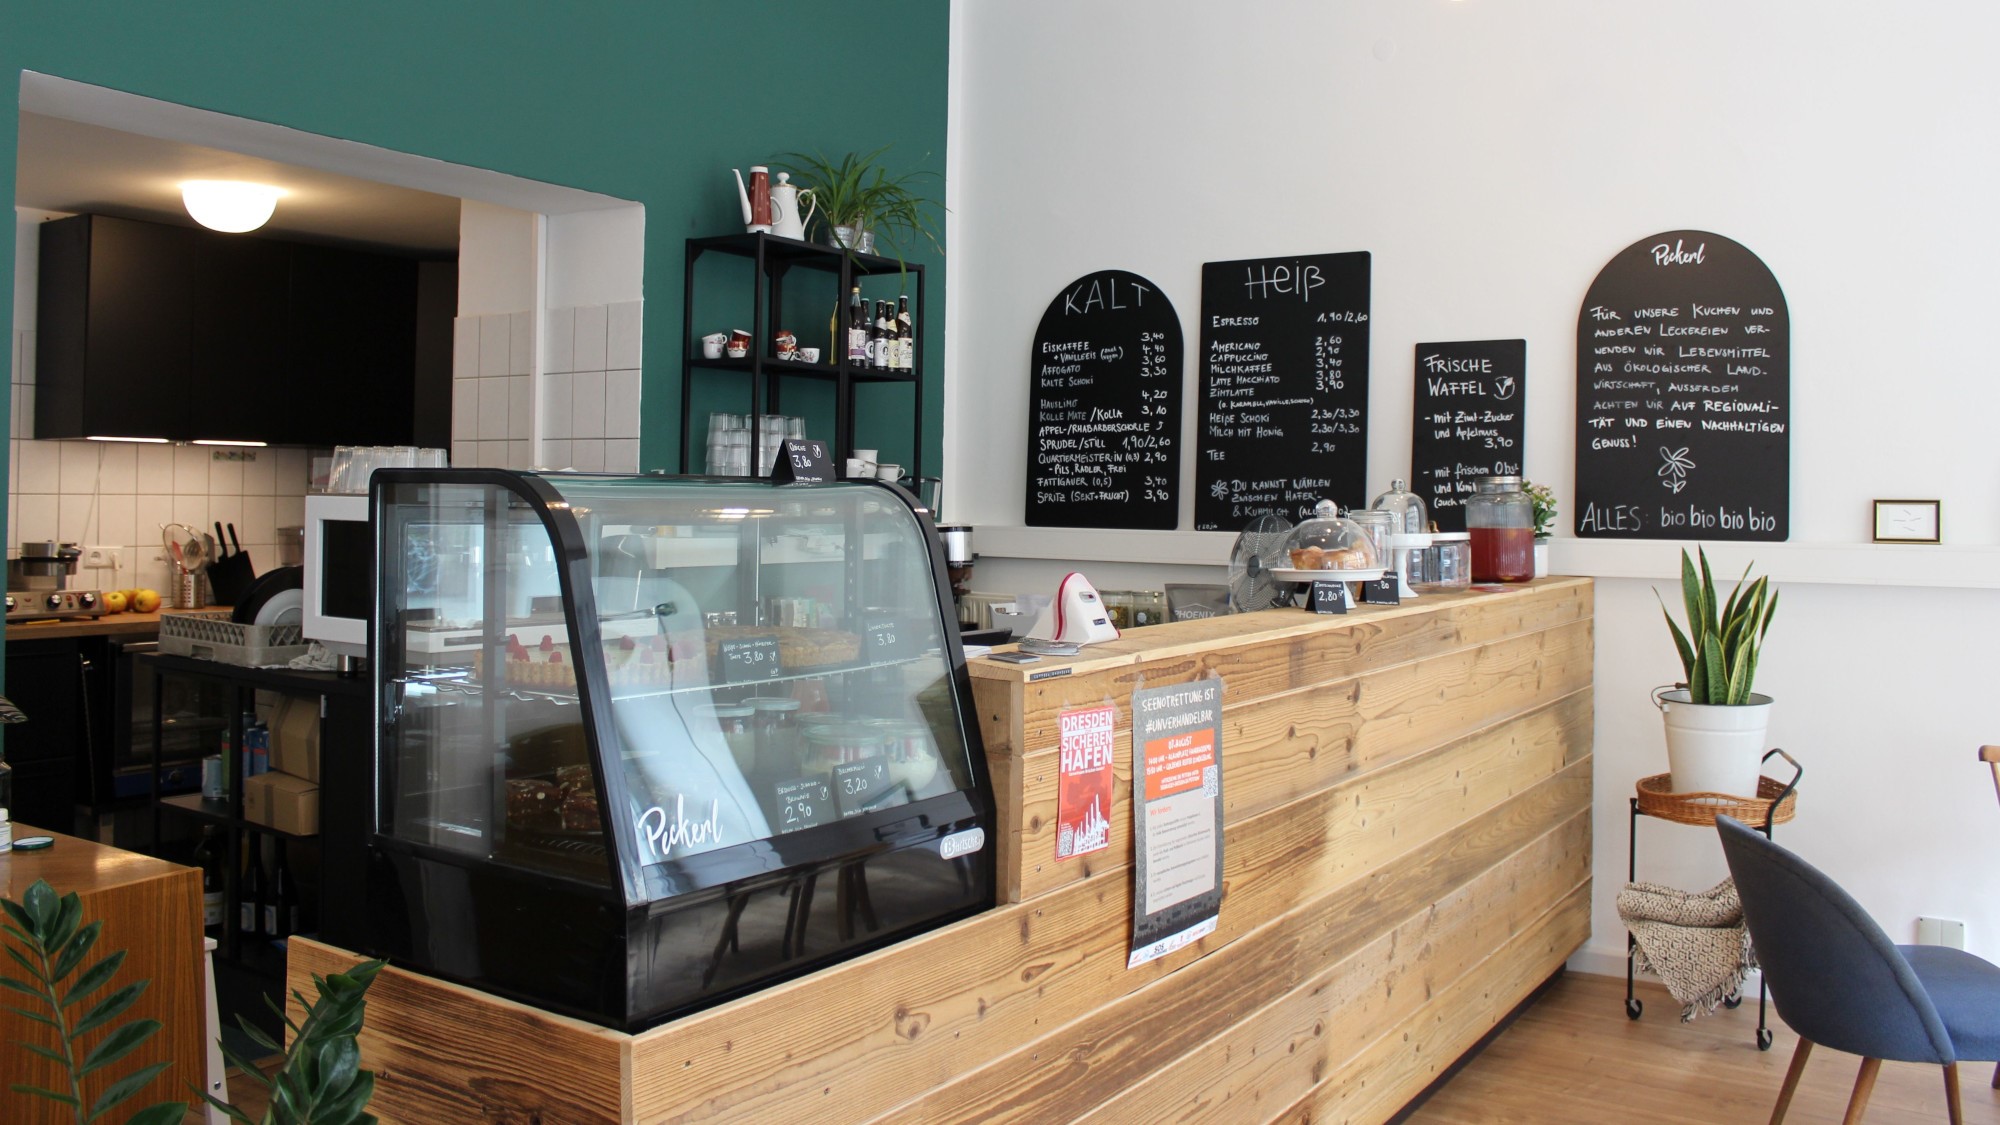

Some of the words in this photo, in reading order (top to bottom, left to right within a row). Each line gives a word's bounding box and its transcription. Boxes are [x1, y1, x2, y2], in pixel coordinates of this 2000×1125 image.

[1244, 260, 1326, 302] Heiß
[1065, 278, 1150, 315] KALT
[1590, 306, 1621, 321] FÜR
[1634, 307, 1680, 319] UNSERE
[1692, 303, 1741, 319] KUCHEN
[1751, 307, 1774, 316] UND
[1212, 315, 1260, 328] ESPRESSO
[1594, 325, 1651, 338] ANDEREN
[1659, 323, 1729, 337] LECKEREIEN
[1744, 324, 1771, 334] VER-
[1042, 341, 1090, 354] EISKAFFEE
[1140, 332, 1165, 343] 3,40
[1142, 343, 1165, 356] 4,40
[1211, 340, 1261, 353] AMERICANO
[1315, 336, 1342, 347] 2,60
[1594, 345, 1636, 355] WENDEN
[1644, 343, 1665, 356] WIR
[1679, 346, 1771, 358] LEBENSMITTEL
[1210, 352, 1269, 363] CAPPUCCINO
[1315, 346, 1340, 358] 2,90
[1423, 353, 1493, 373] FRISCHE
[1041, 364, 1081, 377] AFFOGATO
[1141, 355, 1166, 366] 3,60
[1210, 362, 1273, 374] MILCHKAFFEE
[1315, 358, 1343, 369] 3,40
[1594, 362, 1613, 373] AUS
[1624, 360, 1712, 374] ÖKOLOGISCHER
[1727, 363, 1768, 376] LAND-
[1041, 378, 1064, 388] KALTE
[1068, 375, 1094, 386] SCHOKI
[1140, 367, 1167, 378] 3,30
[1210, 376, 1232, 387] LATTE
[1236, 375, 1281, 385] MACCHIATO
[1315, 370, 1342, 381] 3,80
[1210, 387, 1255, 398] ZIMTLATTE
[1315, 380, 1344, 393] 3,90
[1427, 376, 1487, 397] WAFFEL
[1594, 378, 1661, 395] WIRTSCHAFT,
[1668, 382, 1739, 394] AUSSERDEM
[1040, 398, 1079, 410] HAUSLIMO
[1141, 389, 1168, 402] 4,20
[1594, 400, 1639, 411] ACHTEN
[1646, 399, 1665, 410] WIR
[1670, 401, 1696, 412] AUF
[1704, 399, 1780, 413] REGIONALI-
[1039, 411, 1065, 422] KOLLE
[1067, 410, 1087, 421] MATE
[1141, 405, 1167, 417] 3,10
[1239, 412, 1271, 424] SCHOKI
[1311, 407, 1360, 420] 2,30/3,30
[1434, 411, 1452, 424] mit
[1455, 410, 1515, 423] Zimt-Zucker
[1209, 425, 1234, 438] MILCH
[1238, 426, 1252, 437] MIT
[1256, 425, 1284, 438] HONIG
[1311, 422, 1360, 434] 2,30/3,30
[1434, 428, 1451, 440] und
[1456, 425, 1499, 440] Apfelmus
[1588, 417, 1616, 429] TÄT
[1625, 418, 1648, 428] UND
[1656, 416, 1692, 429] EINEN
[1701, 419, 1785, 434] NACHHALTIGEN
[1122, 435, 1171, 451] 1,90/2,60
[1484, 436, 1514, 449] 3,90
[1143, 452, 1167, 464] 2,90
[1206, 449, 1226, 461] TEE
[1311, 442, 1336, 453] 2,90
[792, 455, 812, 469] 3,80
[1107, 464, 1127, 473] FREI
[1435, 466, 1451, 478] mit
[1494, 461, 1520, 475] Obst
[1036, 474, 1088, 487] FATTIGAUER
[1092, 476, 1112, 488] (0,5)
[1144, 475, 1167, 487] 3,40
[1231, 478, 1248, 493] DU
[1251, 478, 1288, 490] KANNST
[1293, 476, 1331, 490] WÄHLEN
[1434, 481, 1452, 494] und
[1037, 490, 1066, 504] SPRITZ
[1143, 489, 1169, 502] 3,90
[1231, 492, 1278, 503] ZWISCHEN
[1232, 506, 1242, 517] &
[1244, 504, 1290, 517] KUHMILCH
[1661, 505, 1686, 528] bio
[1690, 504, 1716, 529] bio
[1719, 506, 1744, 530] bio
[1749, 506, 1776, 532] bio
[1318, 590, 1338, 602] 2,80
[876, 633, 896, 647] 3,80
[743, 650, 764, 665] 3,80
[1141, 689, 1204, 712] SEENOTRETTUNG
[1204, 687, 1215, 701] IST
[1061, 711, 1113, 731] DRESDEN
[1145, 709, 1214, 734] #UNVERHANDELBAR
[1062, 730, 1113, 753] SICHEREN
[1061, 744, 1113, 773] HAFEN
[843, 777, 868, 795] 3,20
[785, 802, 812, 824] 2,90
[637, 793, 723, 856] Peckerl
